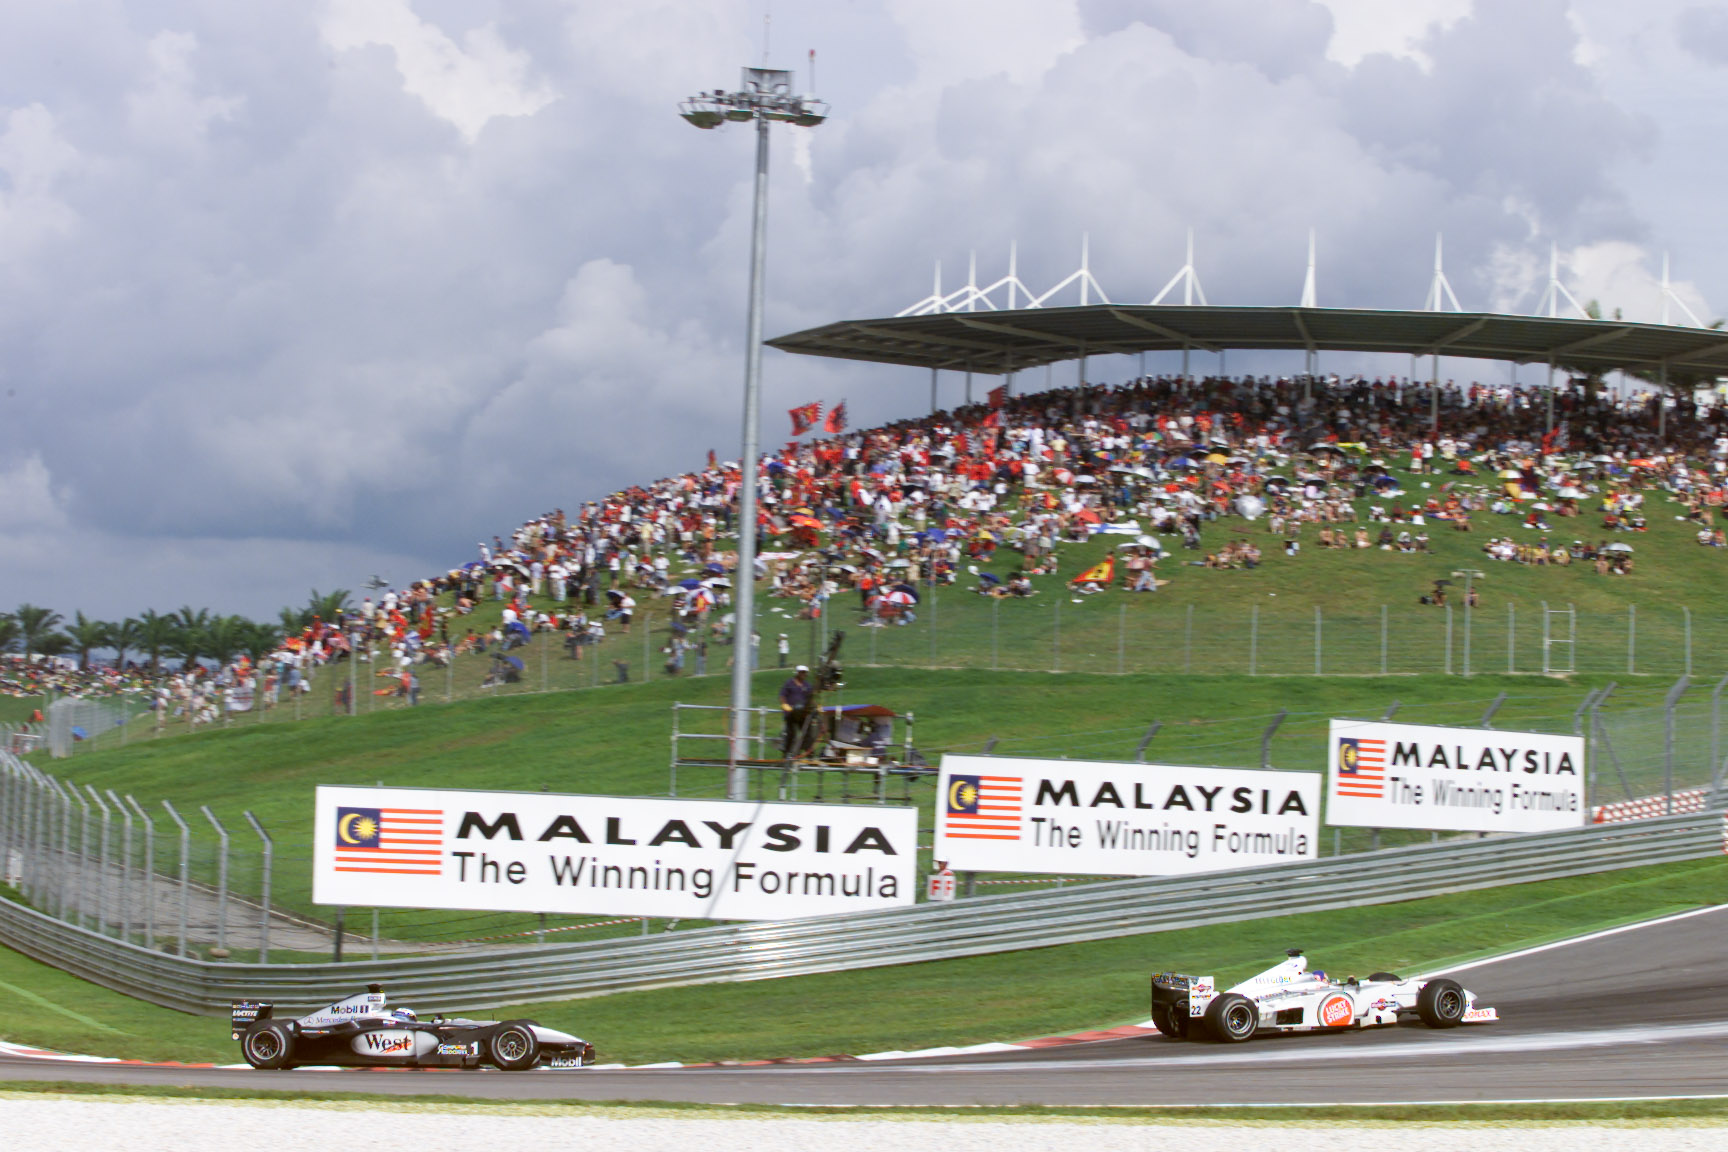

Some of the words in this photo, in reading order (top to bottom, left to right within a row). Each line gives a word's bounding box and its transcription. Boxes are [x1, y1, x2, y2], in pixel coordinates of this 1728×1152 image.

[1391, 741, 1576, 775] MALAYSIA
[1034, 778, 1308, 817] MALAYSIA
[1390, 776, 1424, 805] The
[1432, 778, 1503, 815] Winning
[1510, 783, 1578, 812] Formula
[455, 811, 898, 856] MALAYSIA
[1031, 817, 1082, 848] The
[1097, 819, 1200, 859] Winning
[1212, 824, 1308, 855] Formula
[451, 851, 527, 885] The
[550, 855, 712, 899] Winning
[735, 862, 898, 898] Formula
[330, 1005, 358, 1014] Mobil
[1191, 1005, 1201, 1015] 22
[1325, 999, 1348, 1015] LUCKY
[1326, 1007, 1350, 1023] STRIKE
[364, 1033, 412, 1051] West
[470, 1041, 479, 1055] 1
[551, 1056, 582, 1067] Mobil
